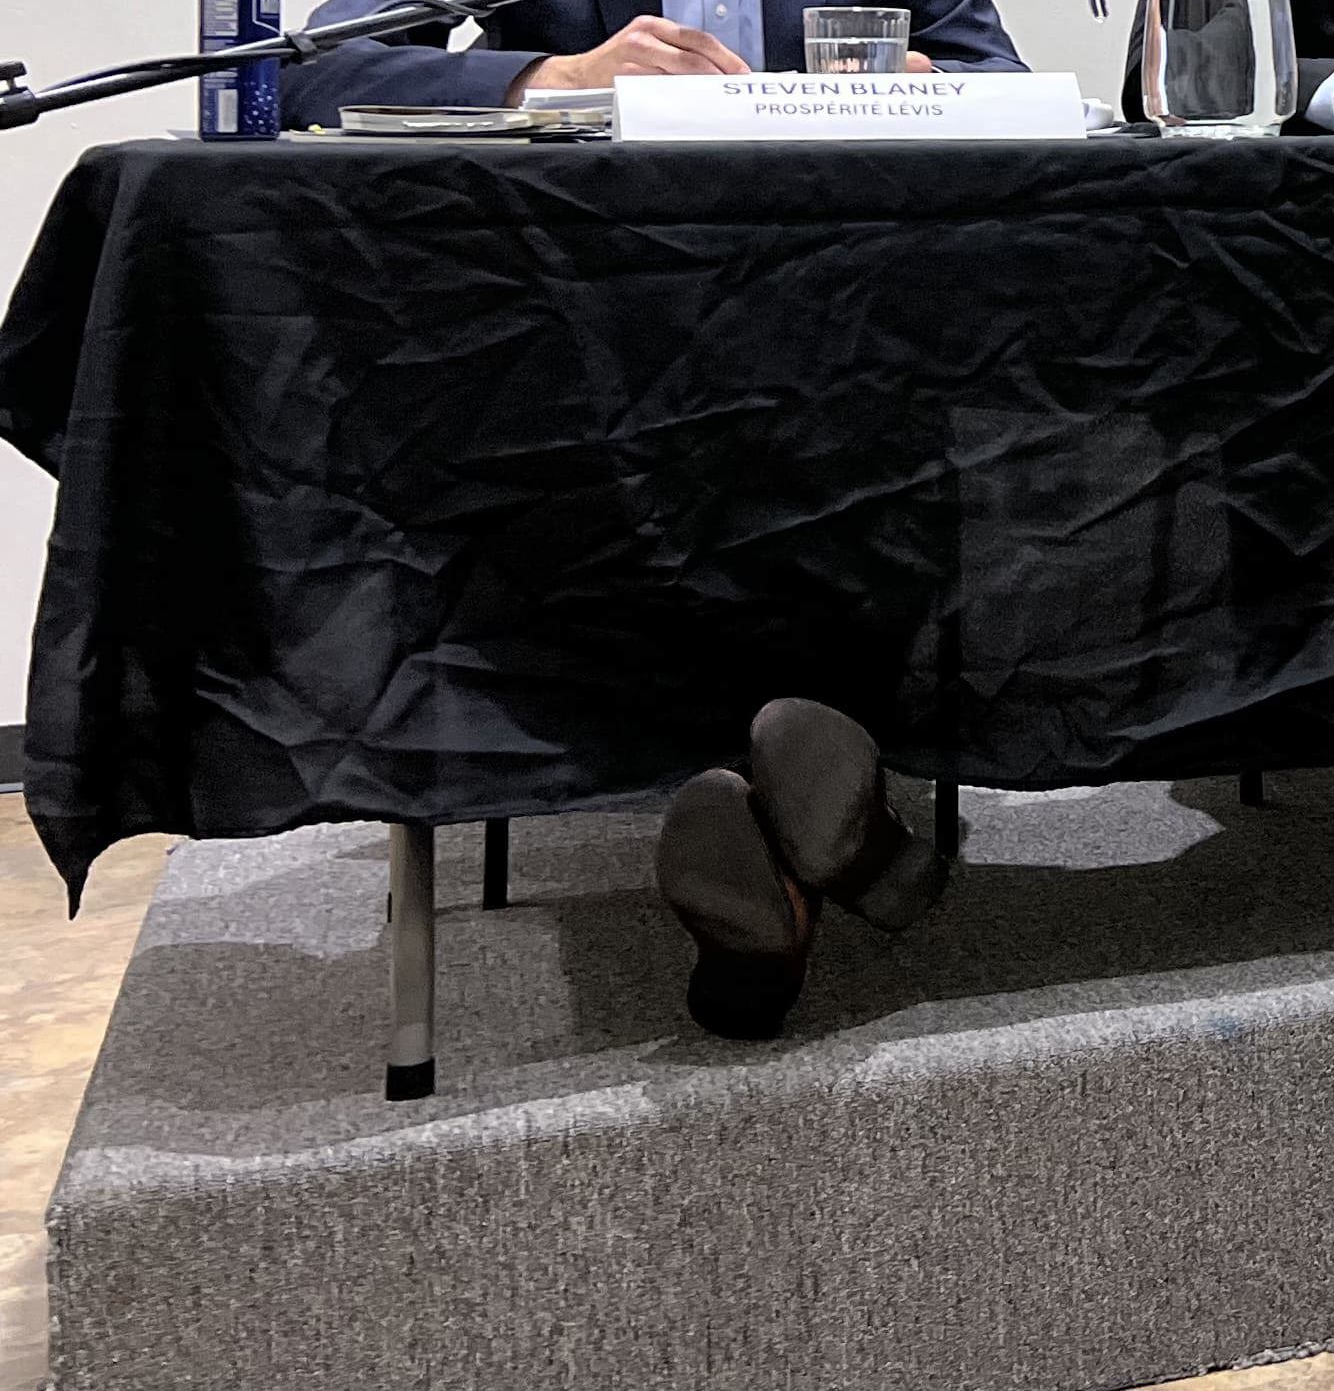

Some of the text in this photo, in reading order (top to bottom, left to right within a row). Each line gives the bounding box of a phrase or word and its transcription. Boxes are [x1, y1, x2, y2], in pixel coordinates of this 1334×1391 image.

[723, 82, 966, 96] STEVEN BLANEY
[755, 99, 943, 116] PROSPÉRITÉ LÉVIS
